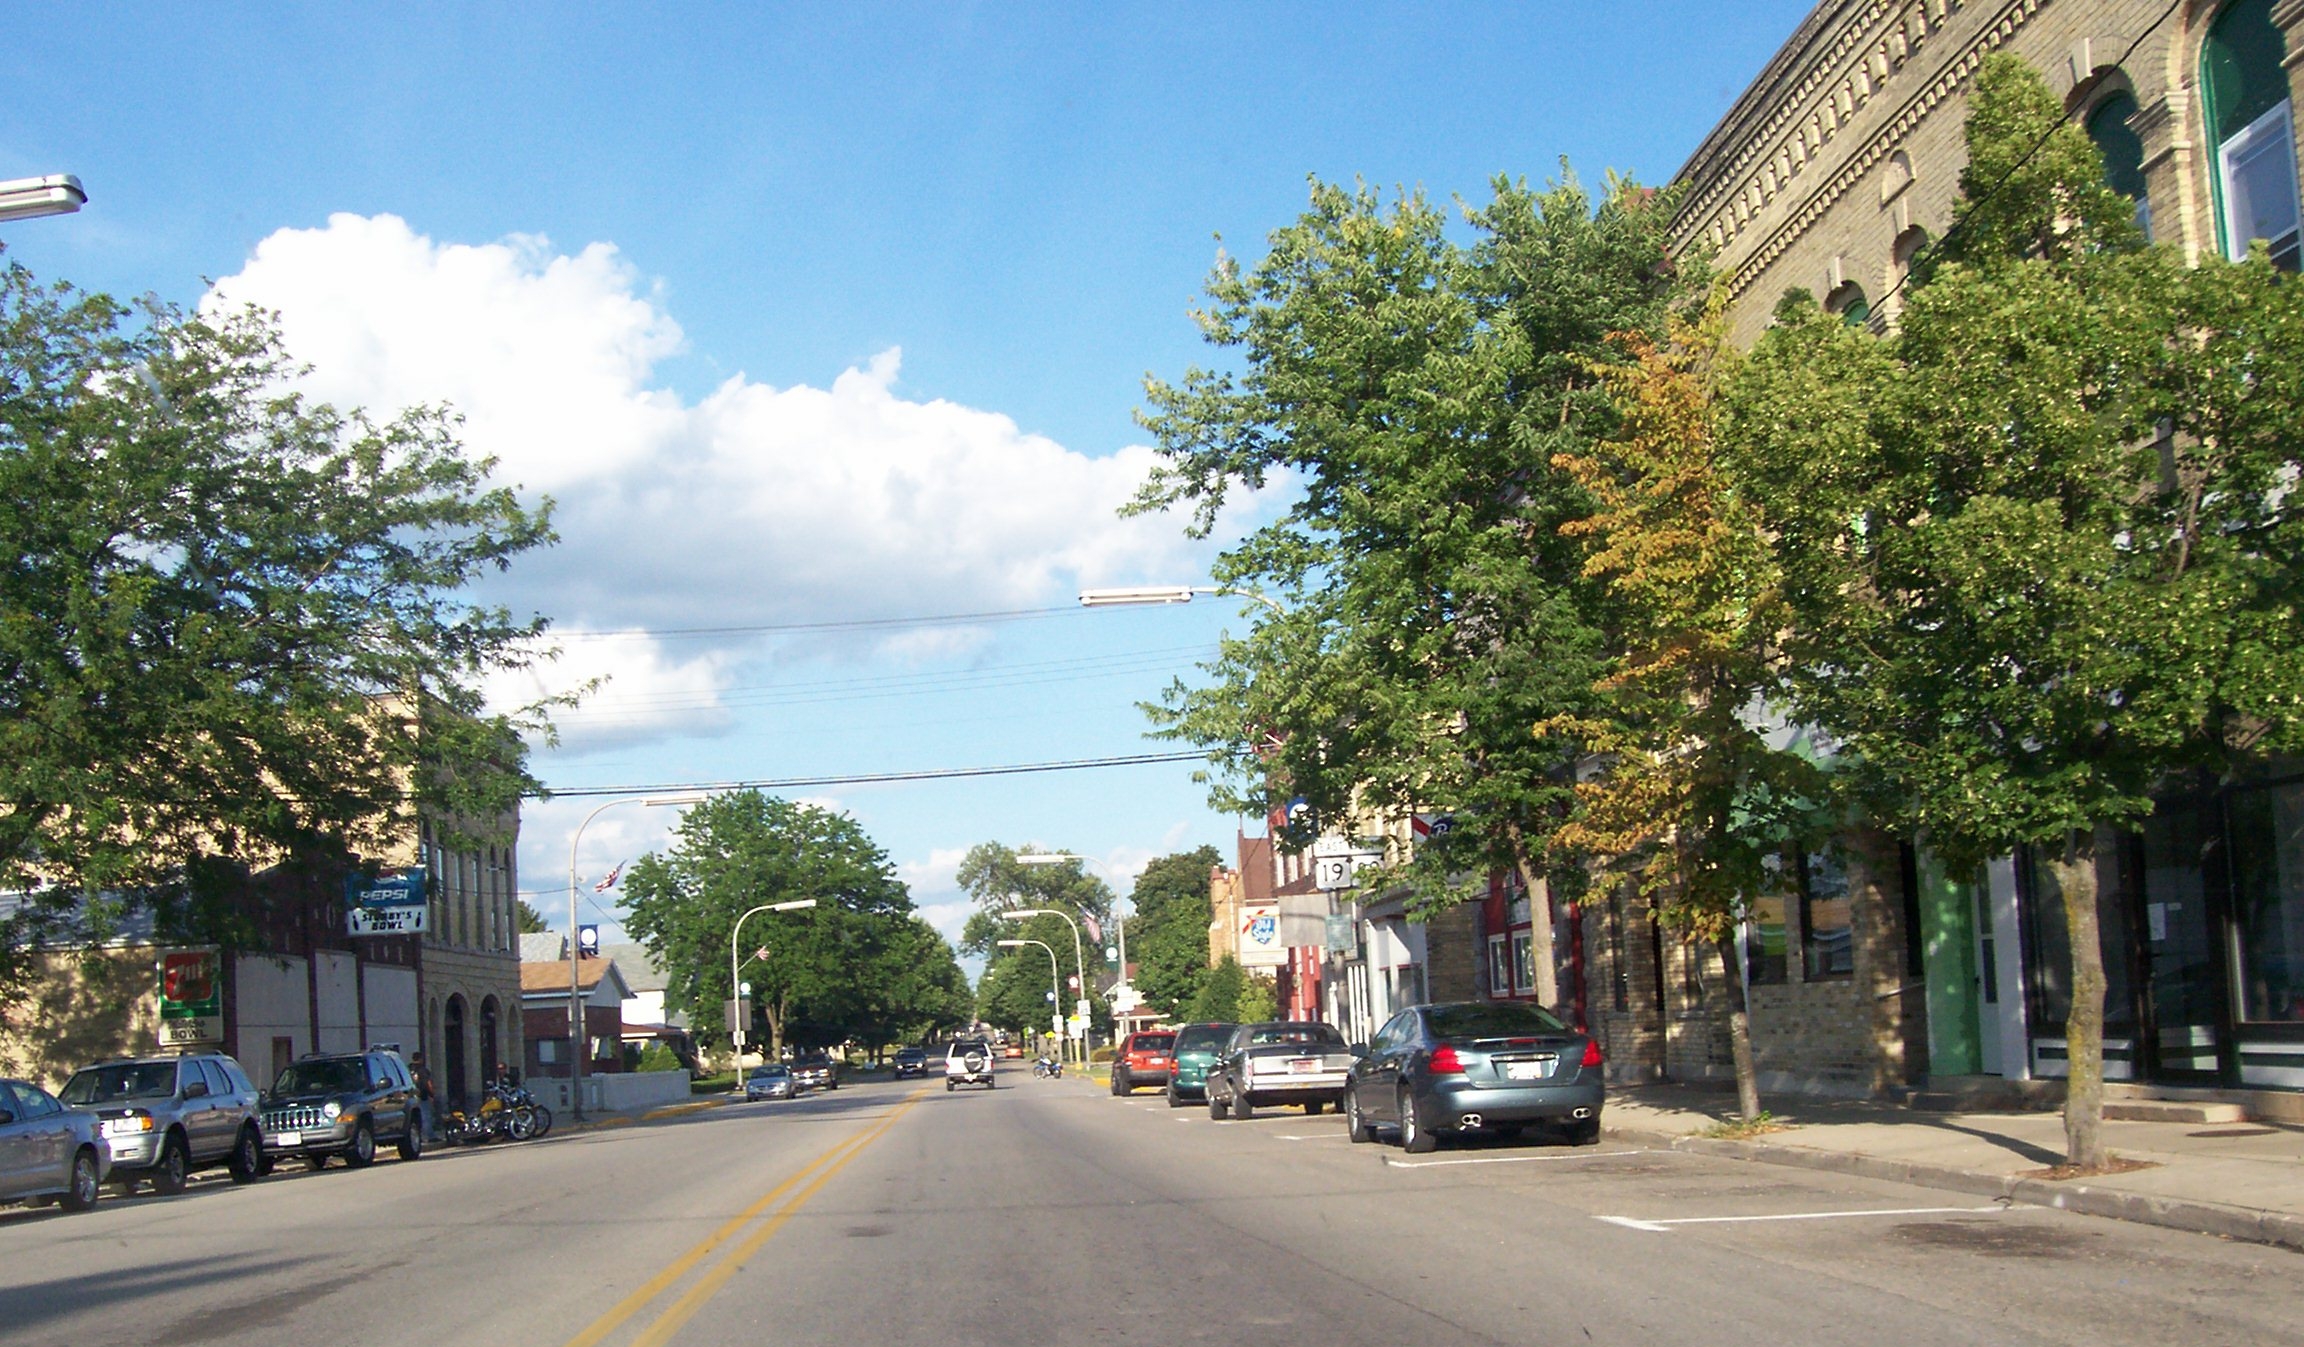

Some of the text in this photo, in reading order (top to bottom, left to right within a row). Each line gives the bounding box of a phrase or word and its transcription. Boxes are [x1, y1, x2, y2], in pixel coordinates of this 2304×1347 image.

[1322, 862, 1343, 882] 19
[360, 888, 409, 901] PEPSI
[372, 920, 403, 931] BOWL
[170, 1029, 208, 1040] BOWL
